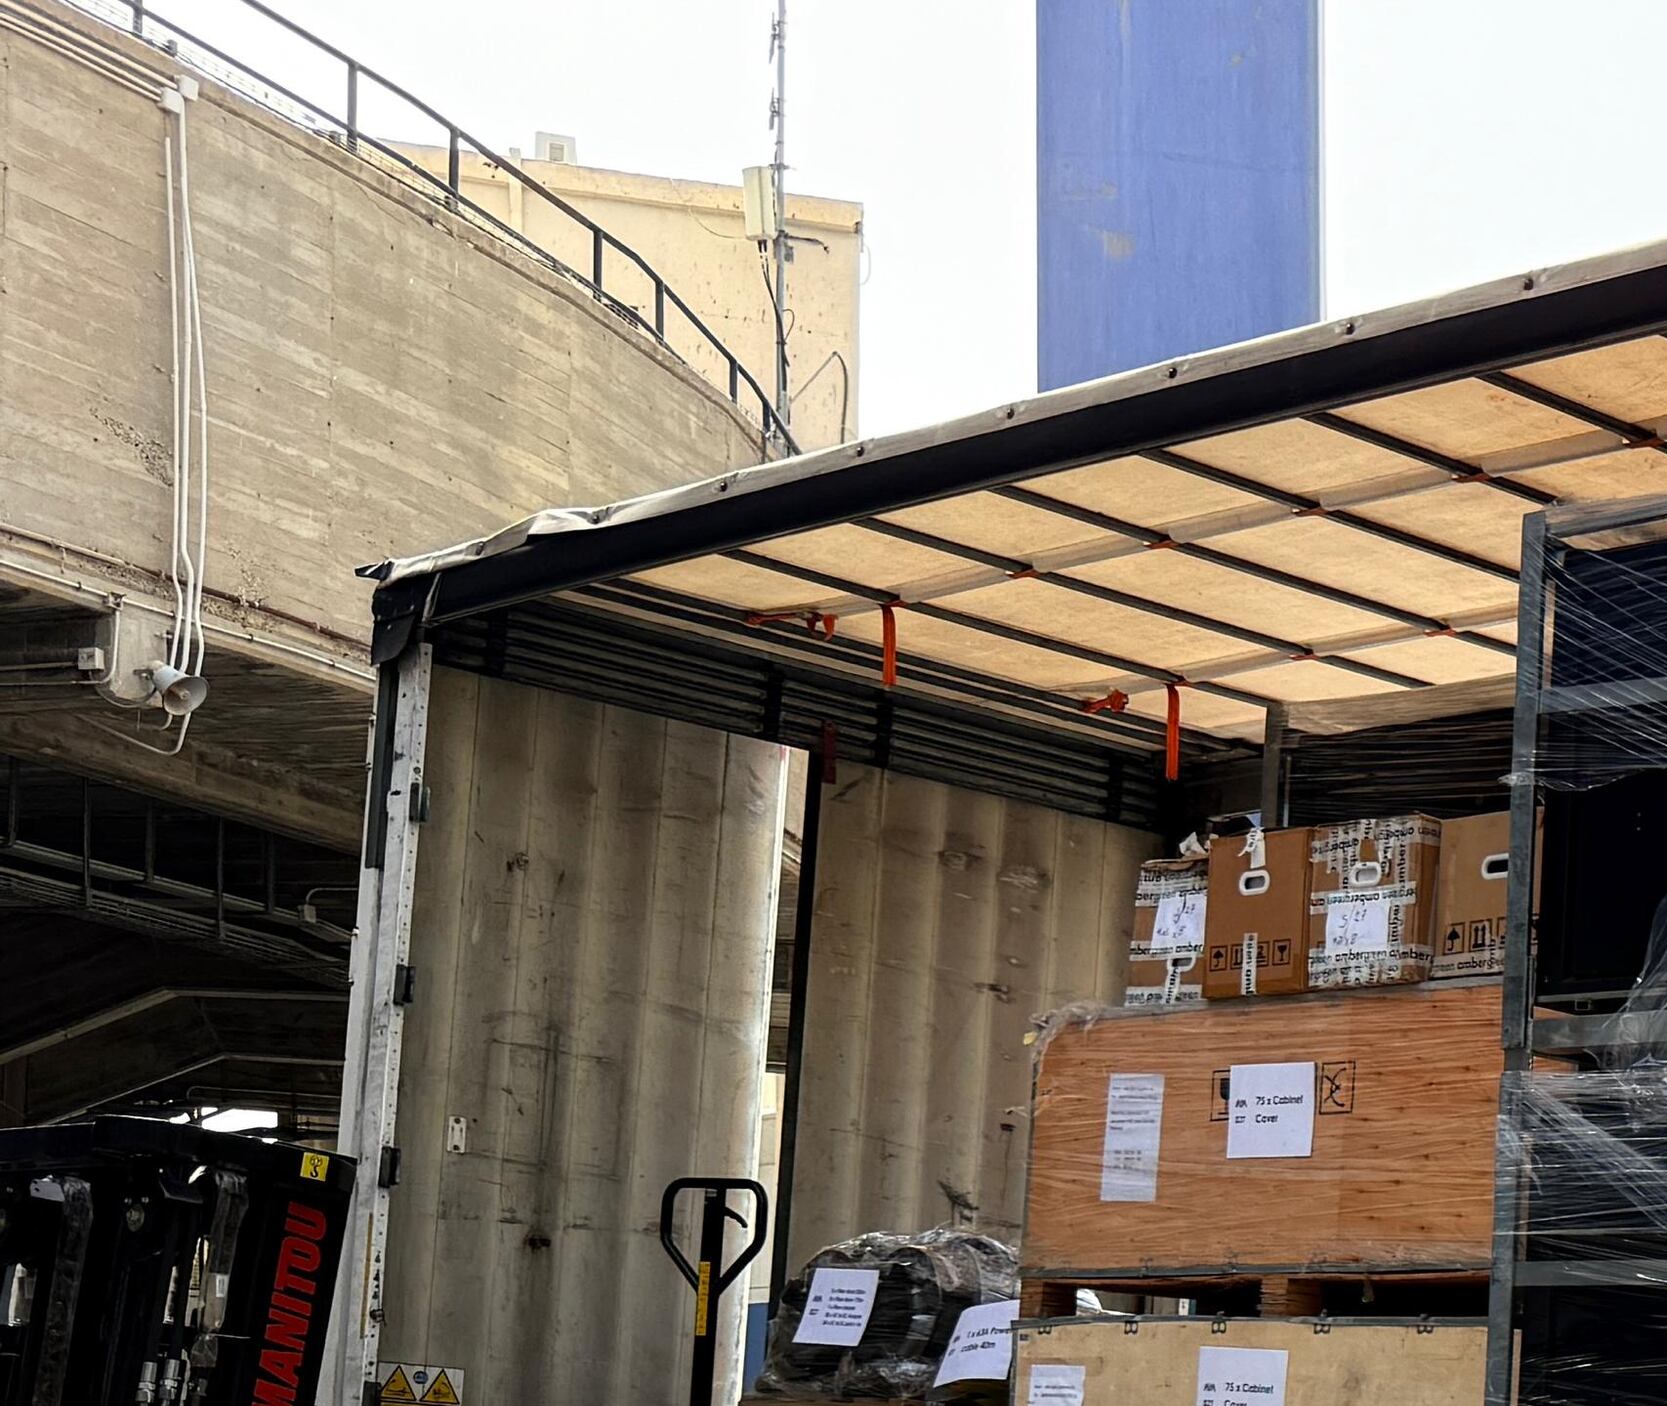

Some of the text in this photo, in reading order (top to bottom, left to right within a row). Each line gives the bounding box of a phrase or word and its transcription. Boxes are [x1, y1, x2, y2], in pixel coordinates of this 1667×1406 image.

[1255, 1096, 1265, 1105] 75
[1273, 1095, 1303, 1105] Cabinet
[1255, 1114, 1278, 1123] Cover
[1225, 1382, 1234, 1392] 75
[1242, 1383, 1274, 1394] Cabinet
